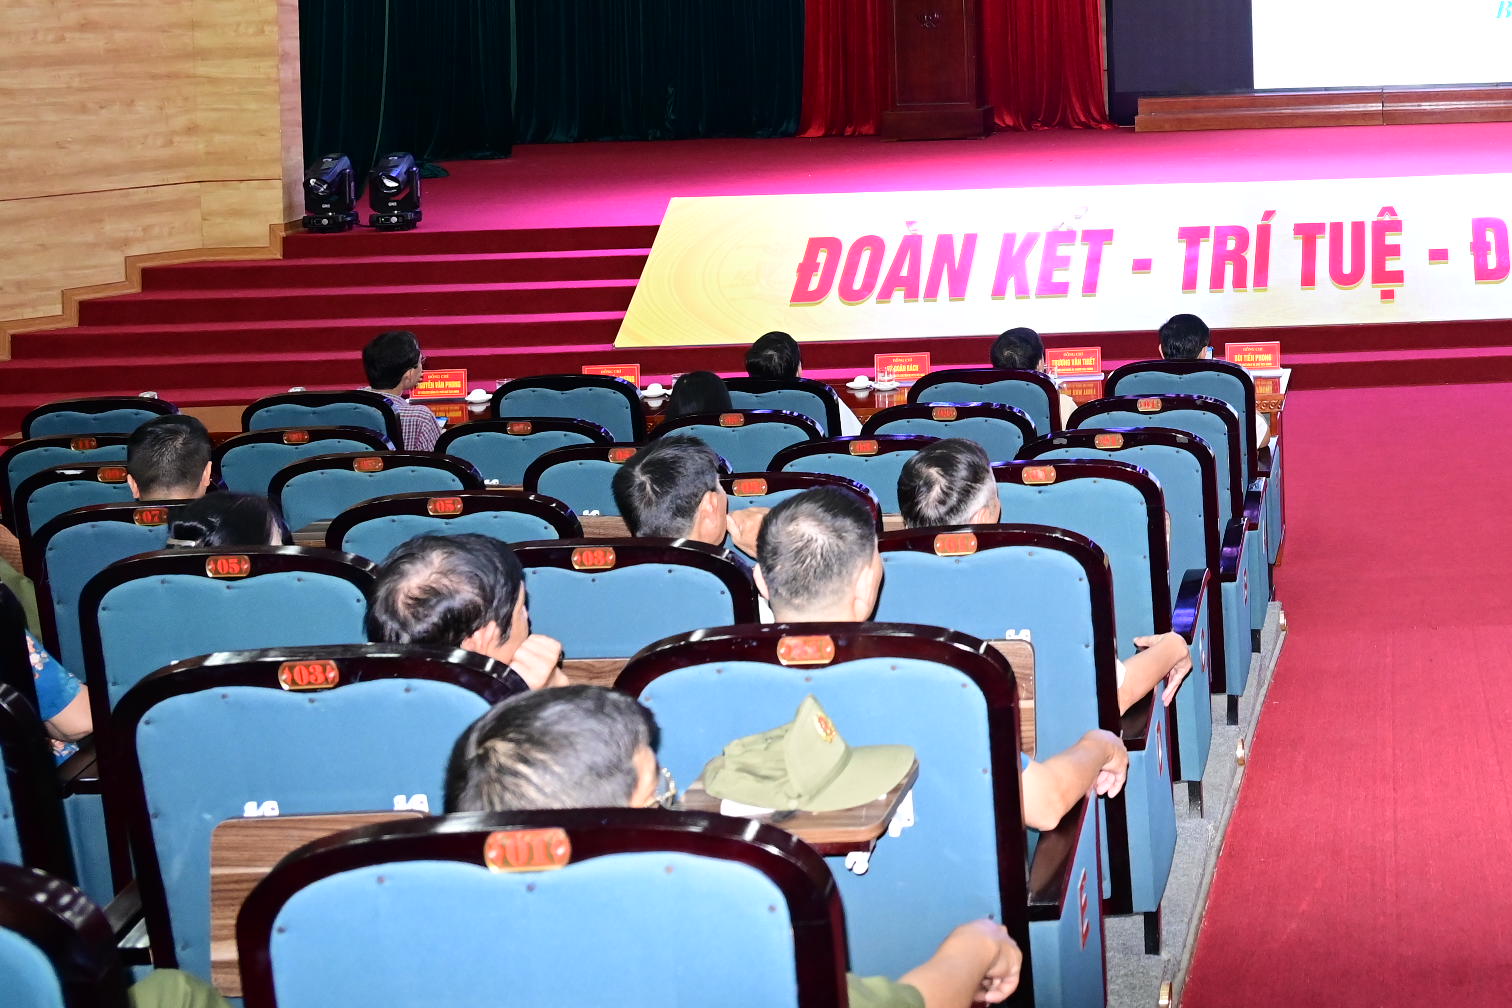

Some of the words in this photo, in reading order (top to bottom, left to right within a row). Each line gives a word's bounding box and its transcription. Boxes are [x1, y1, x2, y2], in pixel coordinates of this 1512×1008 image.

[790, 219, 978, 306] ĐOÀN
[991, 205, 1114, 300] KẾT
[1178, 209, 1278, 294] TRÍ
[1293, 205, 1405, 302] TUỆ
[217, 558, 241, 574] 05
[293, 660, 325, 684] 03
